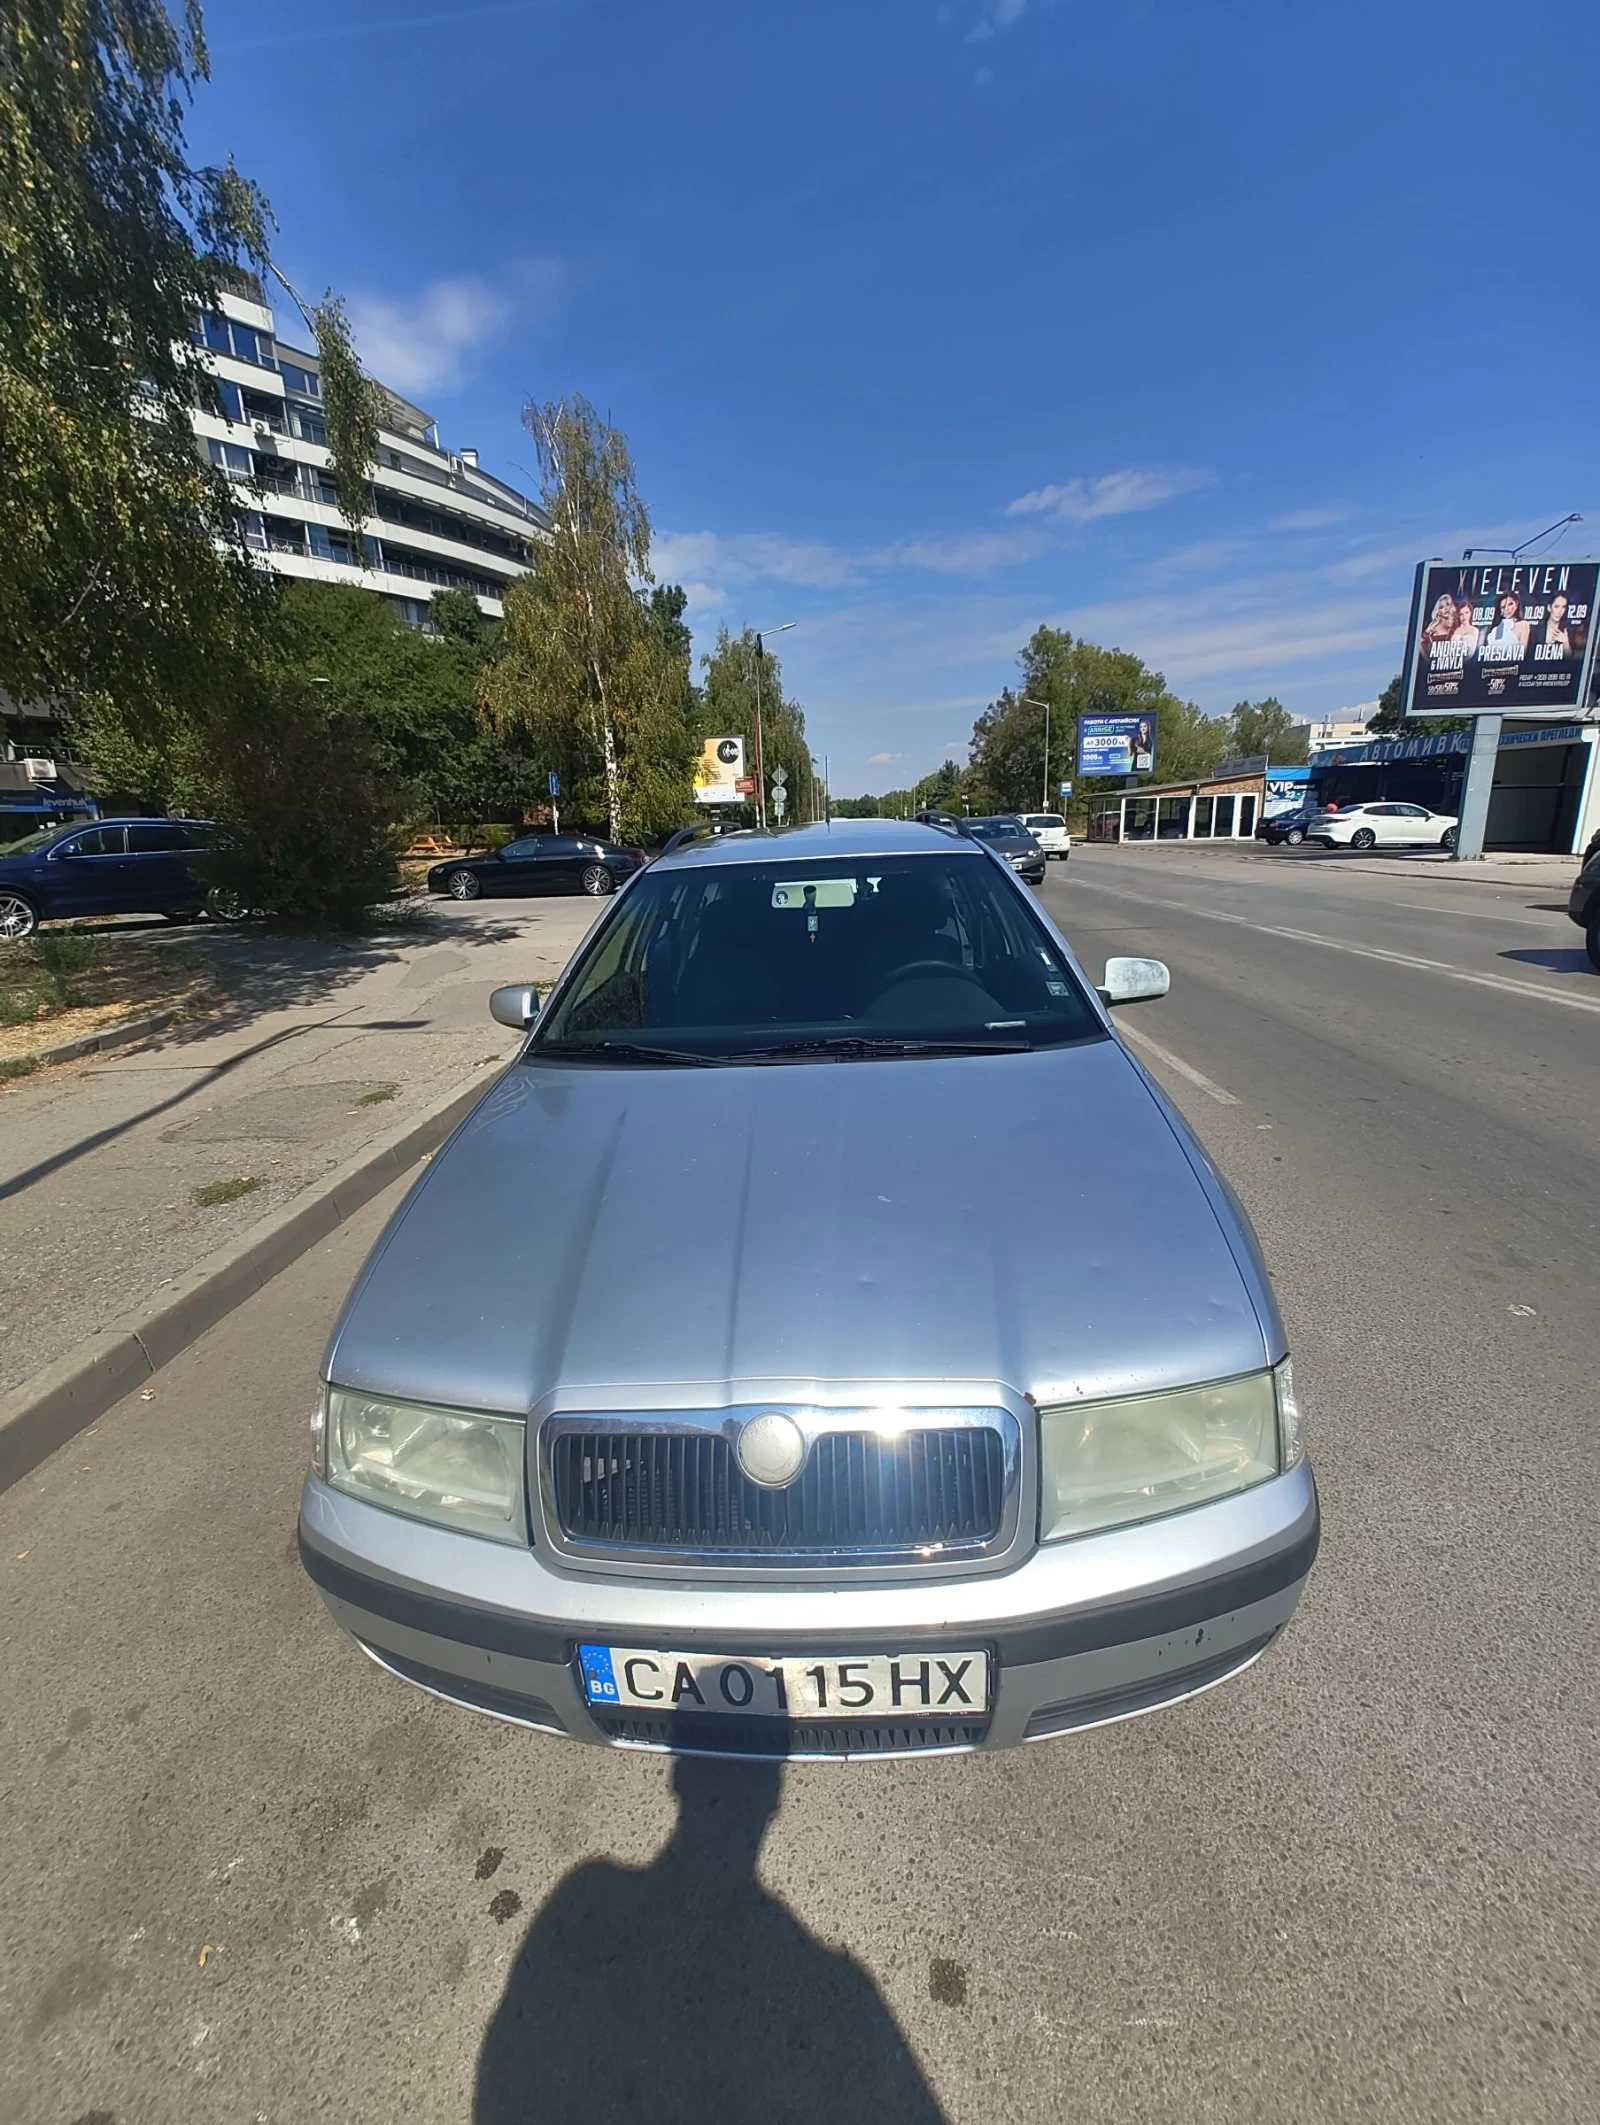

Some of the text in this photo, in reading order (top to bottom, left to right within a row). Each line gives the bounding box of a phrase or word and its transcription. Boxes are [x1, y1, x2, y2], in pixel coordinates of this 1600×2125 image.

[1472, 607, 1495, 621] 08.09
[1524, 606, 1544, 620] 10.09
[1567, 605, 1587, 619] 12.09
[1429, 641, 1468, 658] ANDREA
[1477, 645, 1525, 662] PRESLAVA
[1534, 644, 1564, 660] DJENA
[1094, 738, 1118, 747] 3000
[1360, 734, 1469, 761] АВТОМИВК
[1270, 782, 1293, 792] VIP
[43, 797, 88, 807] levenhuk
[590, 1679, 616, 1697] BG
